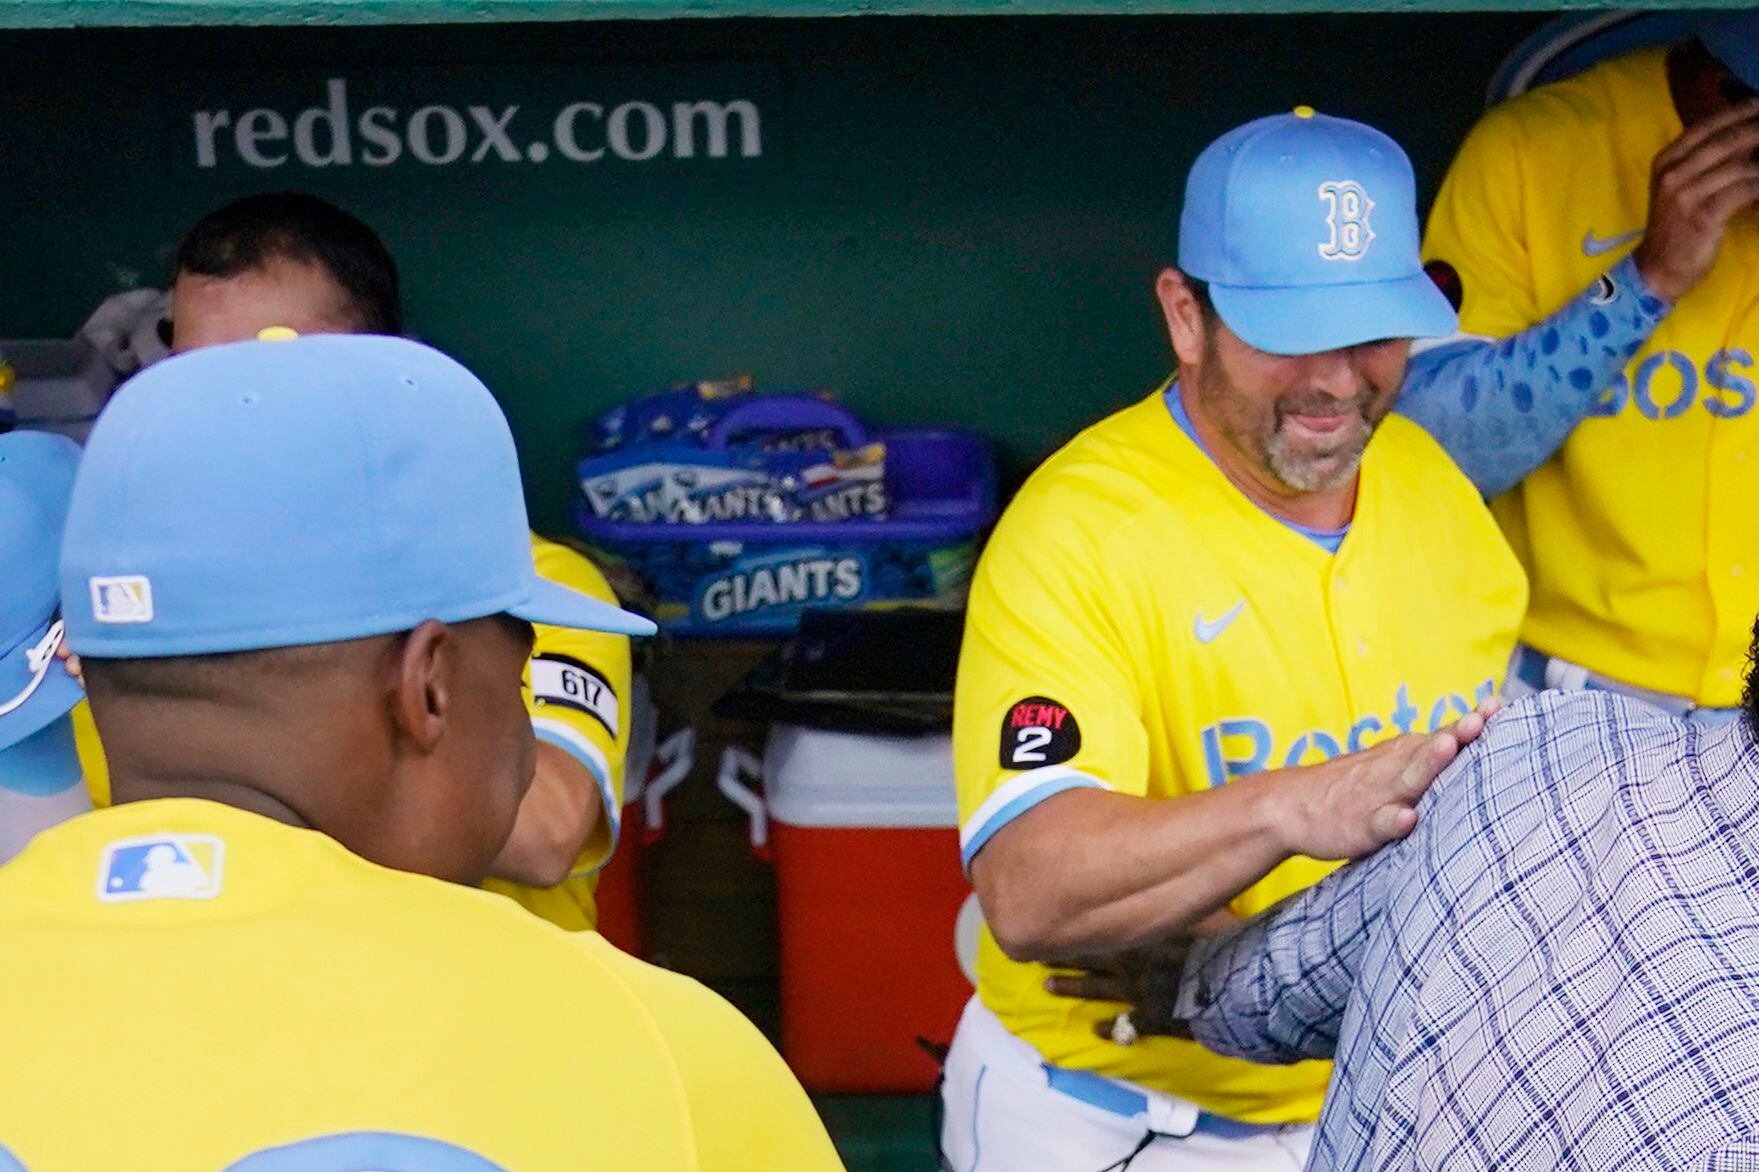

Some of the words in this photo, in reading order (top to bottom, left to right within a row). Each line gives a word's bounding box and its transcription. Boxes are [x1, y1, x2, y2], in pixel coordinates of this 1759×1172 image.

[193, 78, 762, 168] redsox.com
[1317, 180, 1377, 261] B
[702, 558, 860, 621] GIANTS
[562, 669, 602, 706] 617
[1010, 703, 1068, 730] REMY
[1012, 726, 1052, 763] 2
